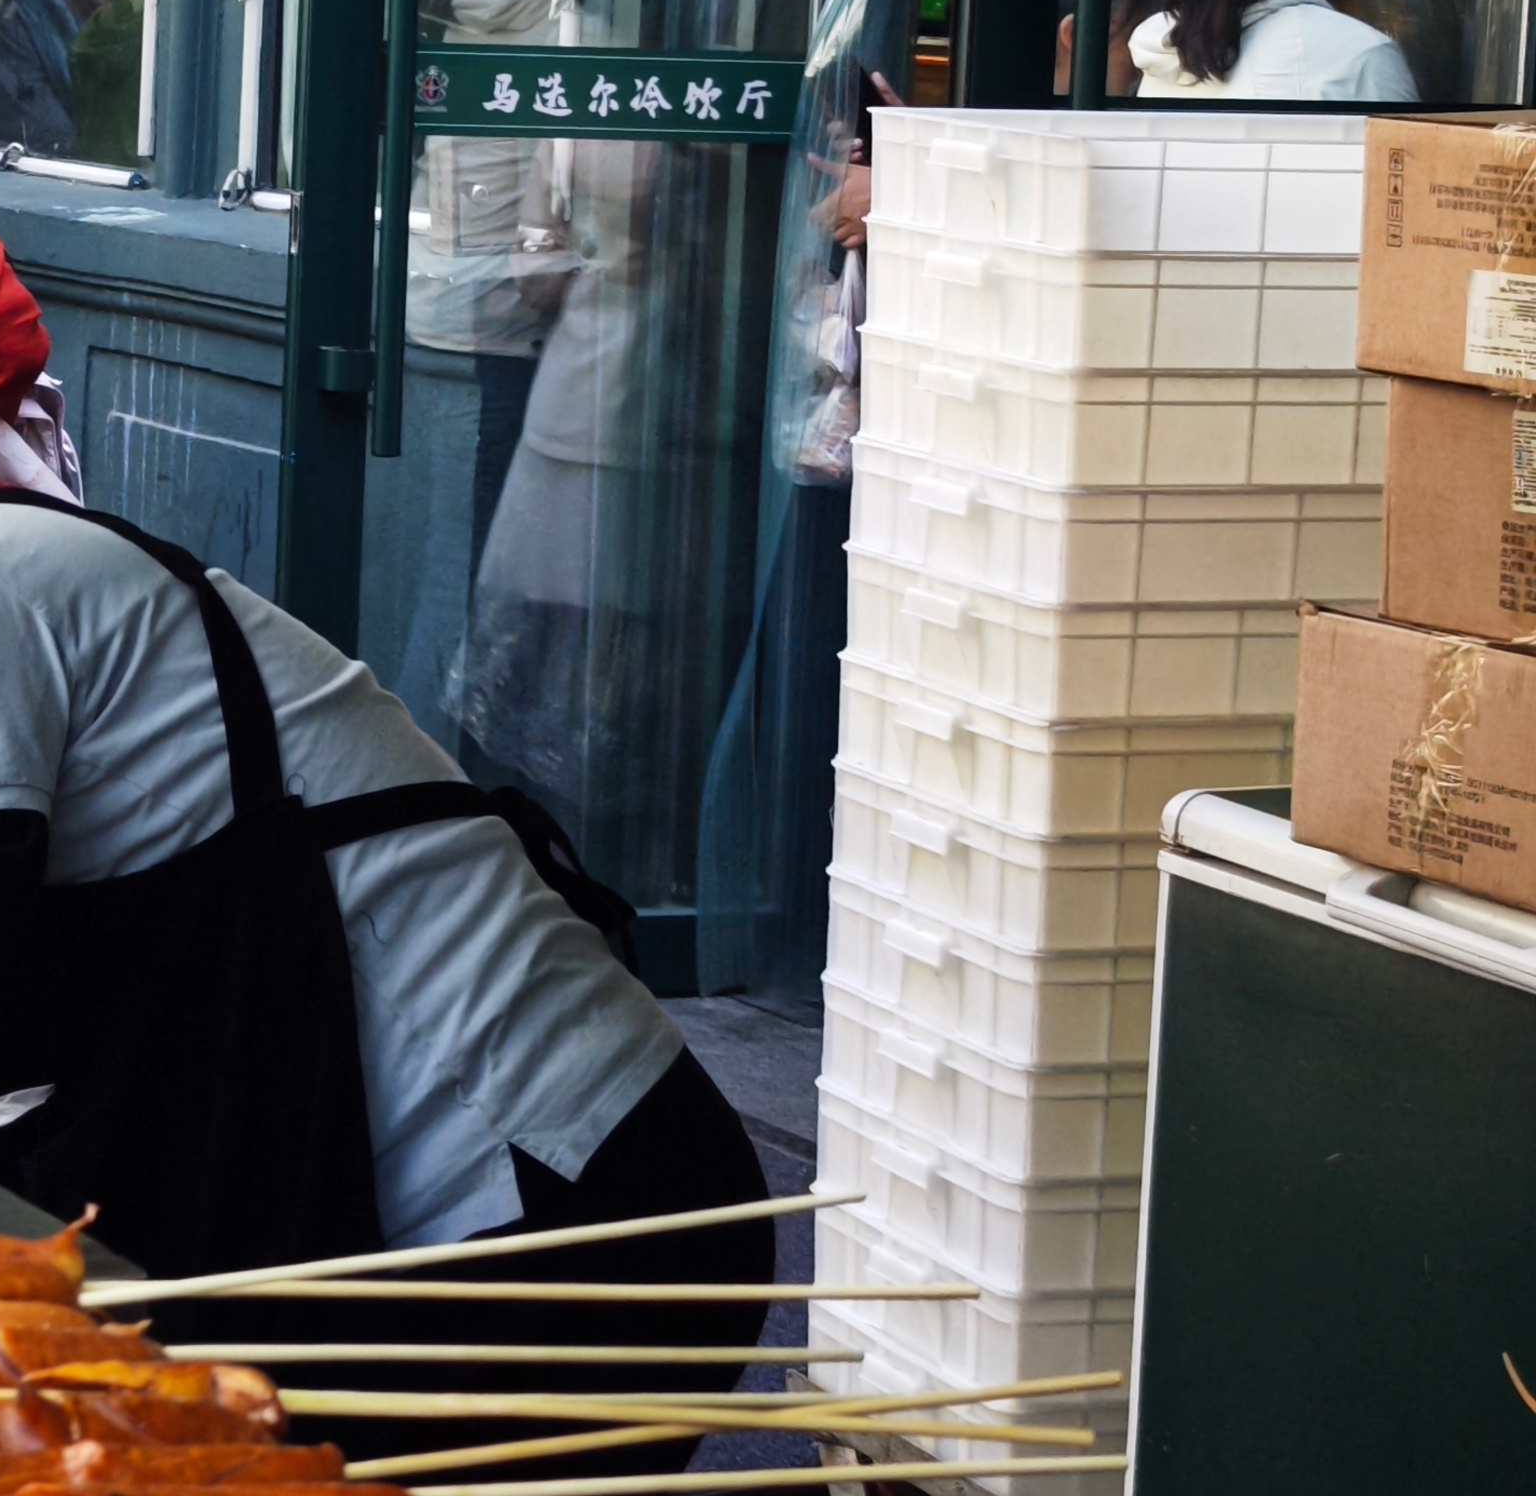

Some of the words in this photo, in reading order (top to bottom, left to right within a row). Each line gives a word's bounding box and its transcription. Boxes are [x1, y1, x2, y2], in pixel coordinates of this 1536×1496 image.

[482, 72, 773, 120] 马迭尔冷饮厅
